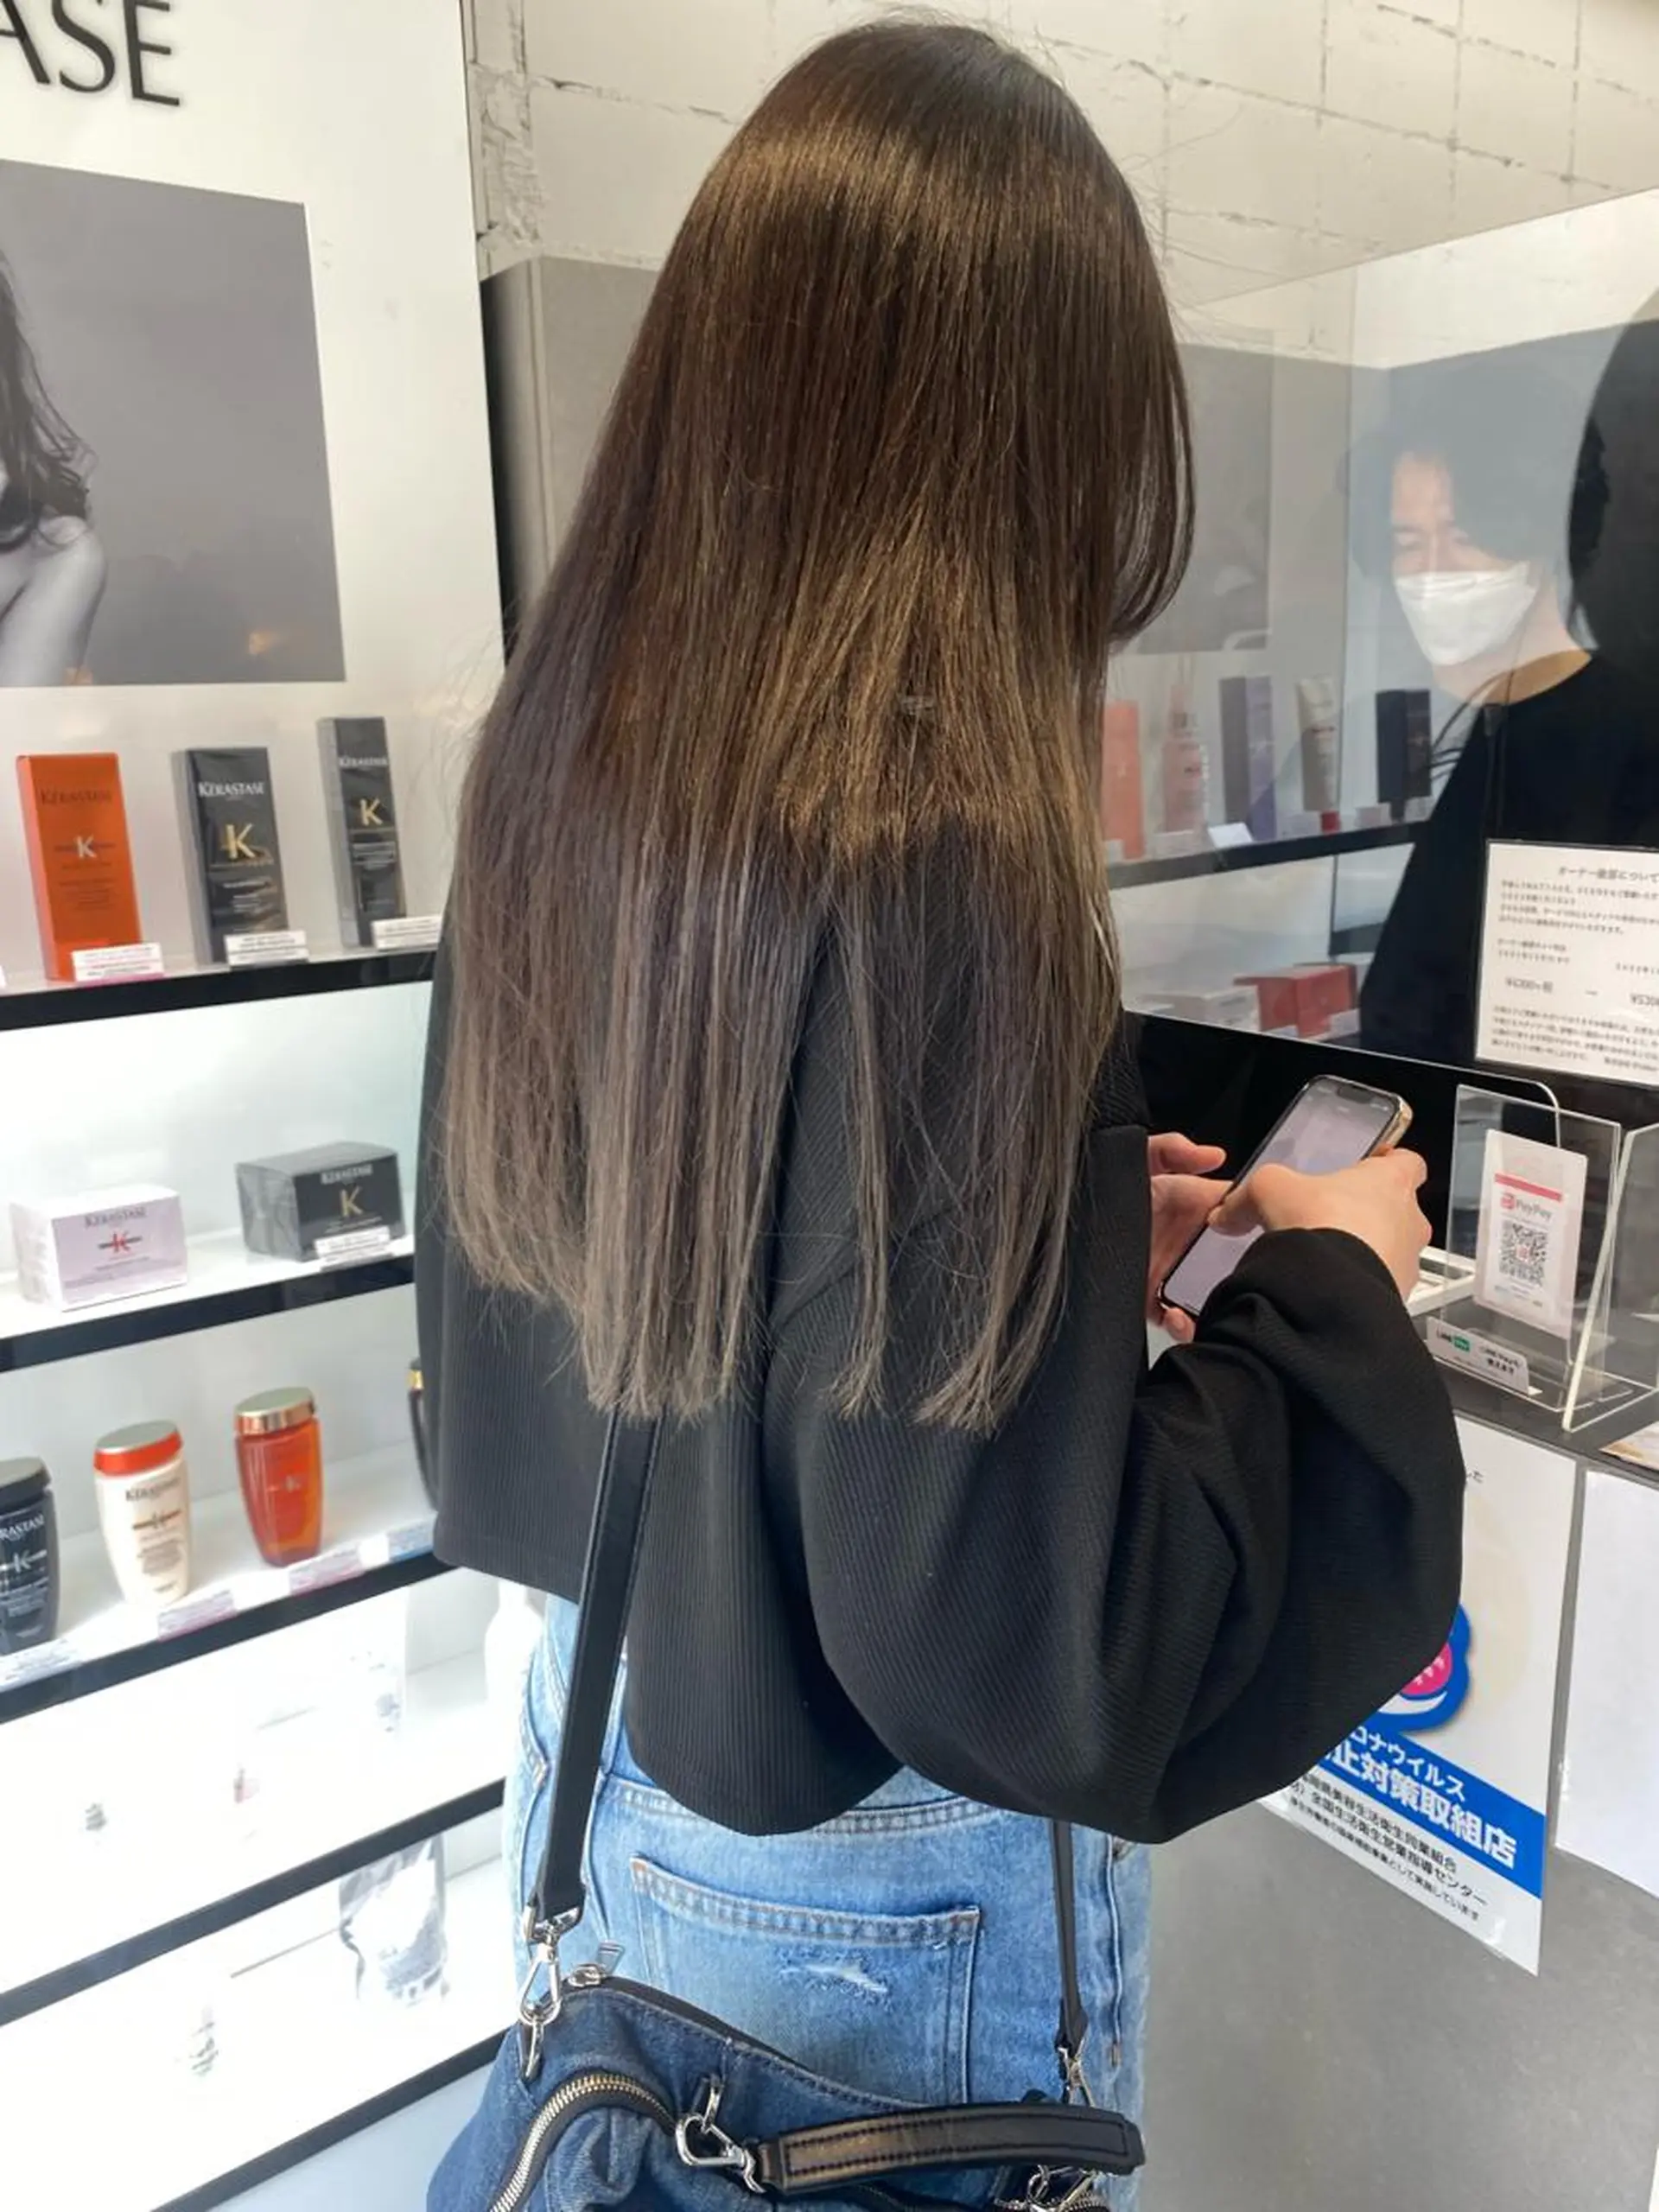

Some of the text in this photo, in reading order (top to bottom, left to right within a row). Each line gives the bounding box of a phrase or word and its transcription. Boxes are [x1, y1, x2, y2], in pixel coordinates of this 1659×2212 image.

[360, 798, 383, 825] K
[73, 834, 97, 859] K
[226, 823, 256, 860] K
[340, 1185, 362, 1217] K
[1325, 1740, 1516, 1870] 止対策取組店
